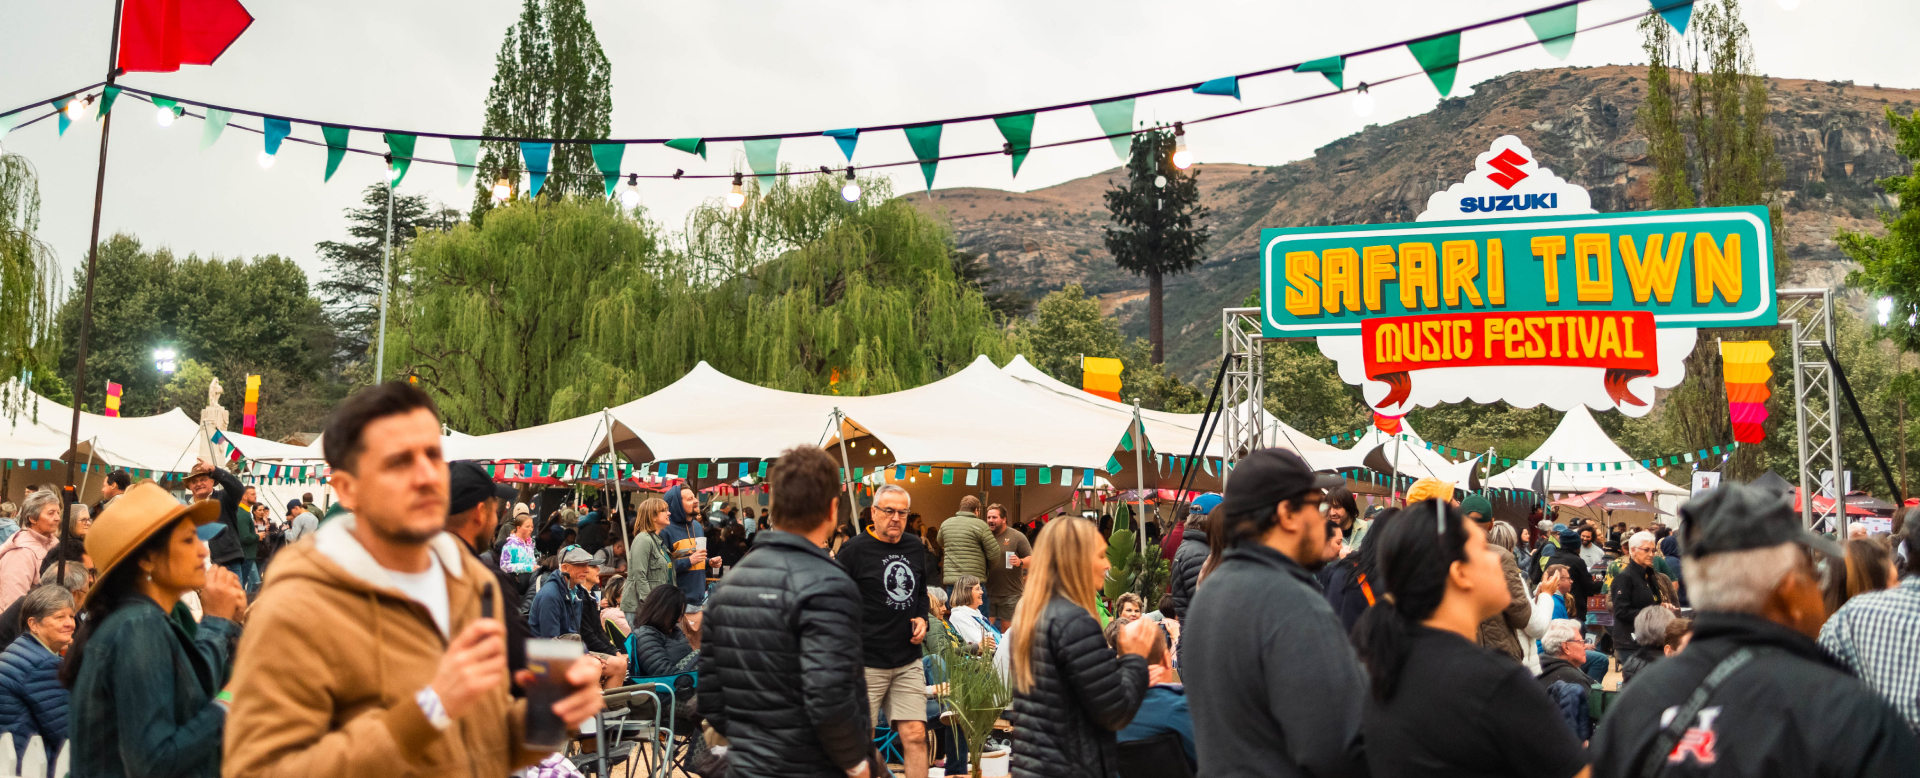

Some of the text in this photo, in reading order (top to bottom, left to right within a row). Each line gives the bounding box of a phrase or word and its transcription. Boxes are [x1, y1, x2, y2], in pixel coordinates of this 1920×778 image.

[1460, 193, 1557, 213] SUZUKI
[1285, 231, 1743, 316] SAFARI TOWN
[1376, 319, 1473, 363] MUSIC
